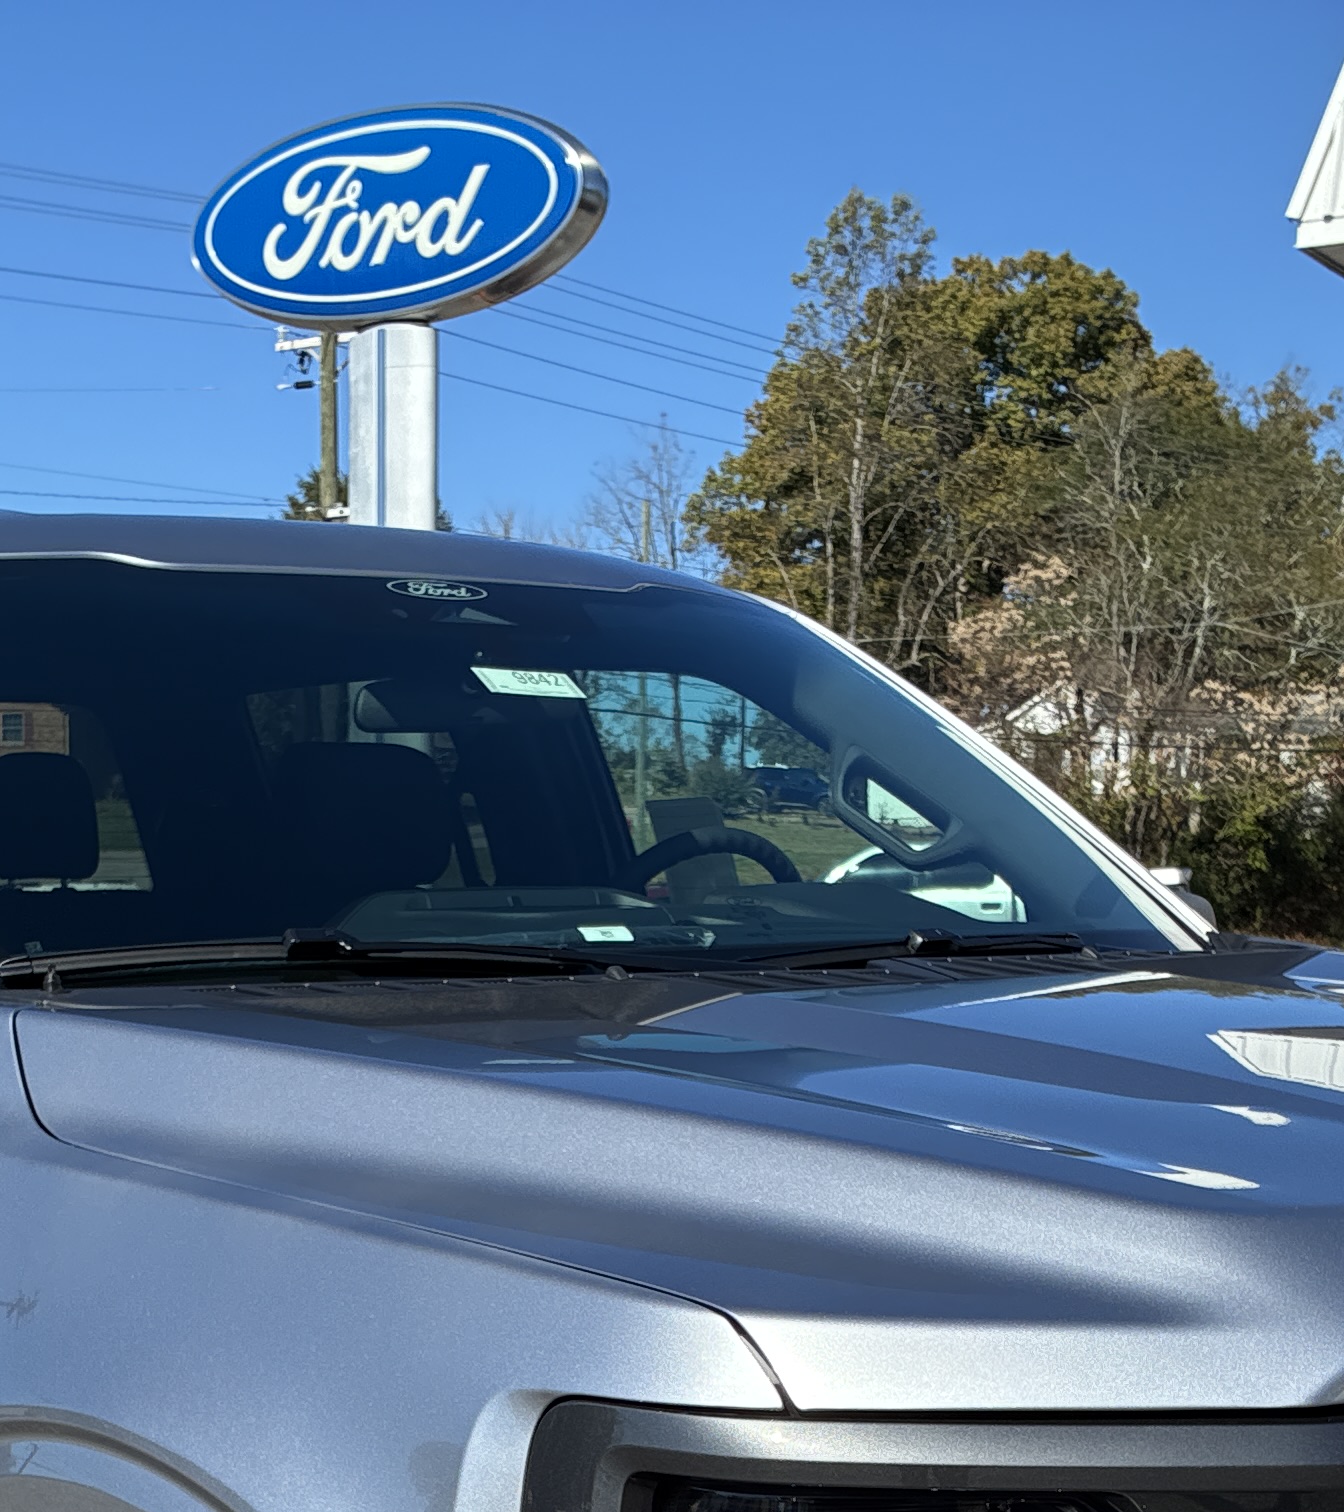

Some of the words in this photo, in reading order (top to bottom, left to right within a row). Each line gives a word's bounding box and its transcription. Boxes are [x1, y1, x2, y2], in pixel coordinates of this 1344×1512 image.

[262, 145, 491, 280] Ford
[407, 581, 472, 598] Ford
[511, 671, 566, 687] 9842
